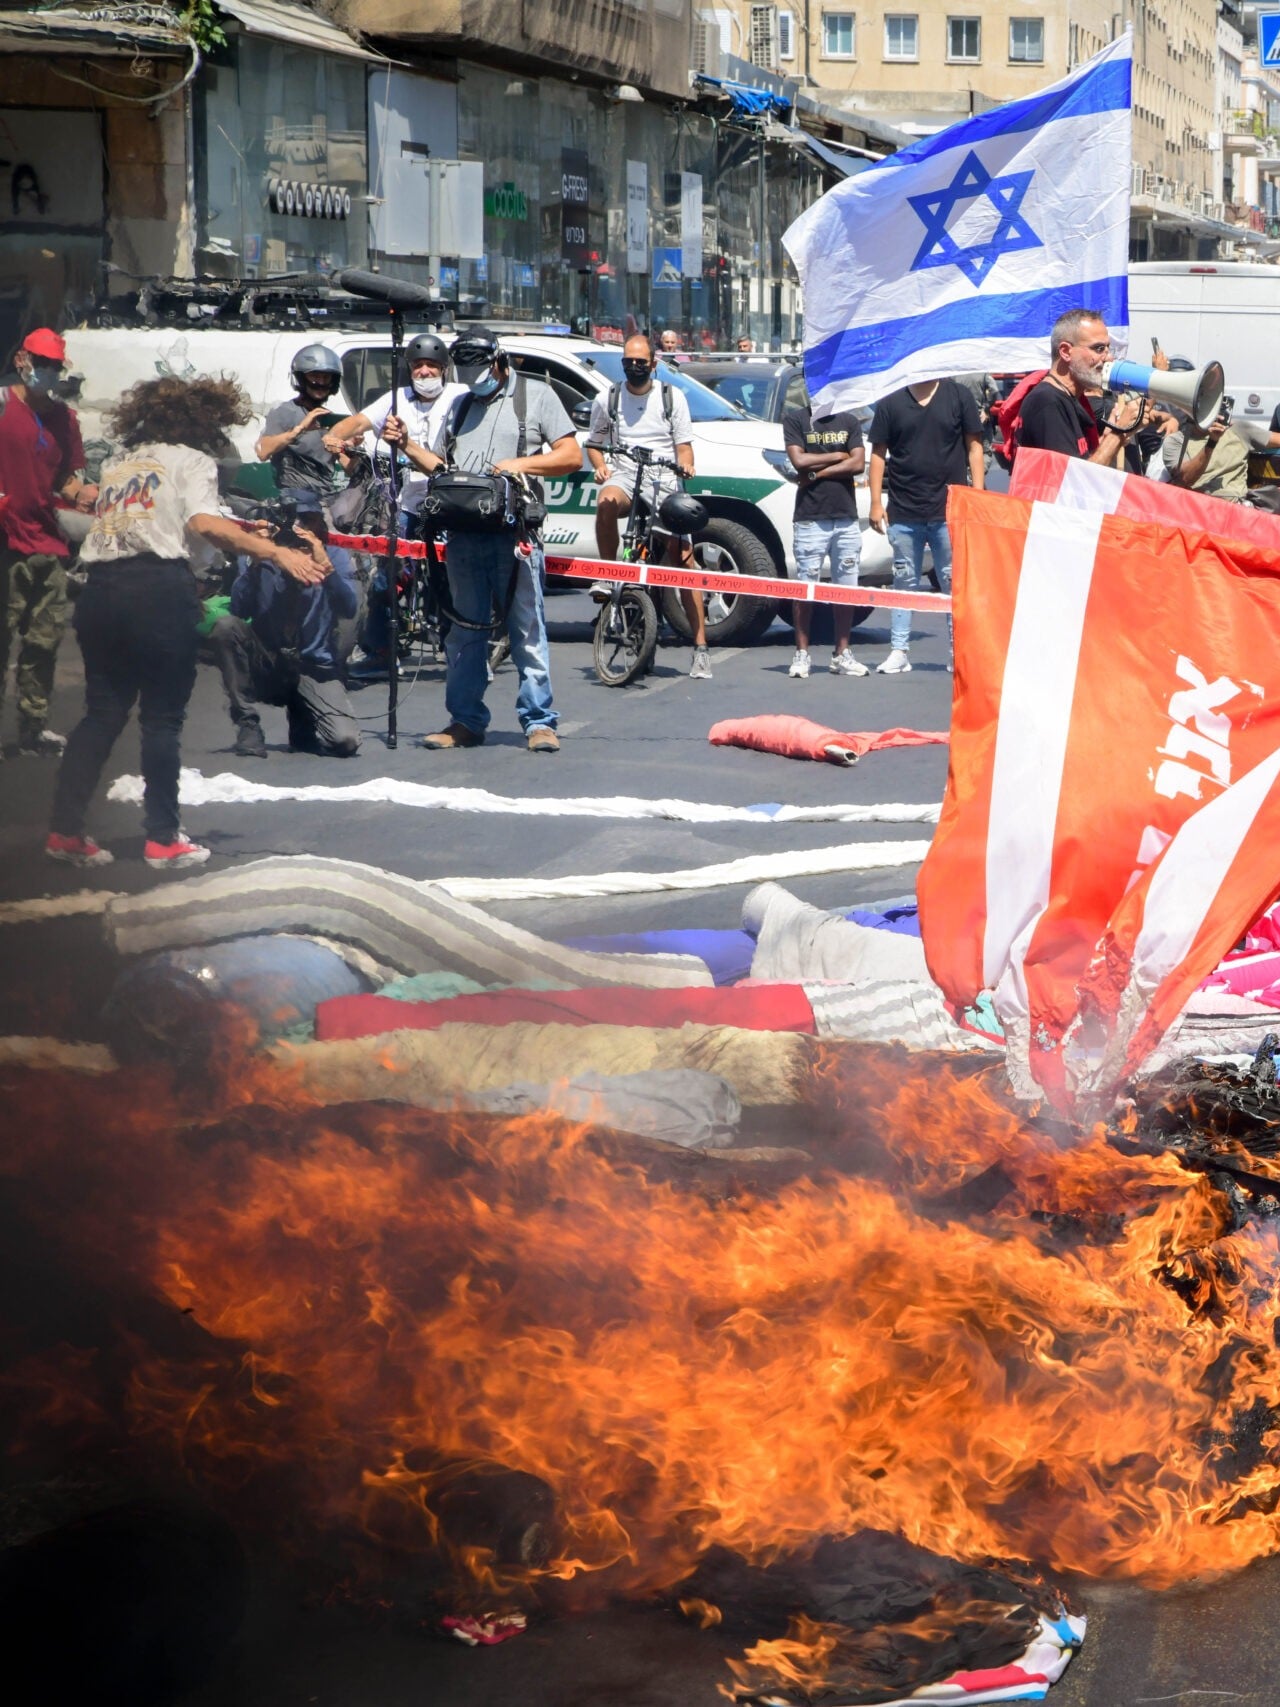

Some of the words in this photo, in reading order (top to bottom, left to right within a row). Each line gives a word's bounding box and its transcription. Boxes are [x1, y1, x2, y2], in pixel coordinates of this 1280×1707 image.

[276, 186, 351, 215] COLORADO
[598, 567, 635, 578] משטרת
[651, 571, 678, 583] מעבר
[681, 575, 695, 585] אין
[714, 577, 745, 589] ישראל
[766, 584, 803, 595] משטרת
